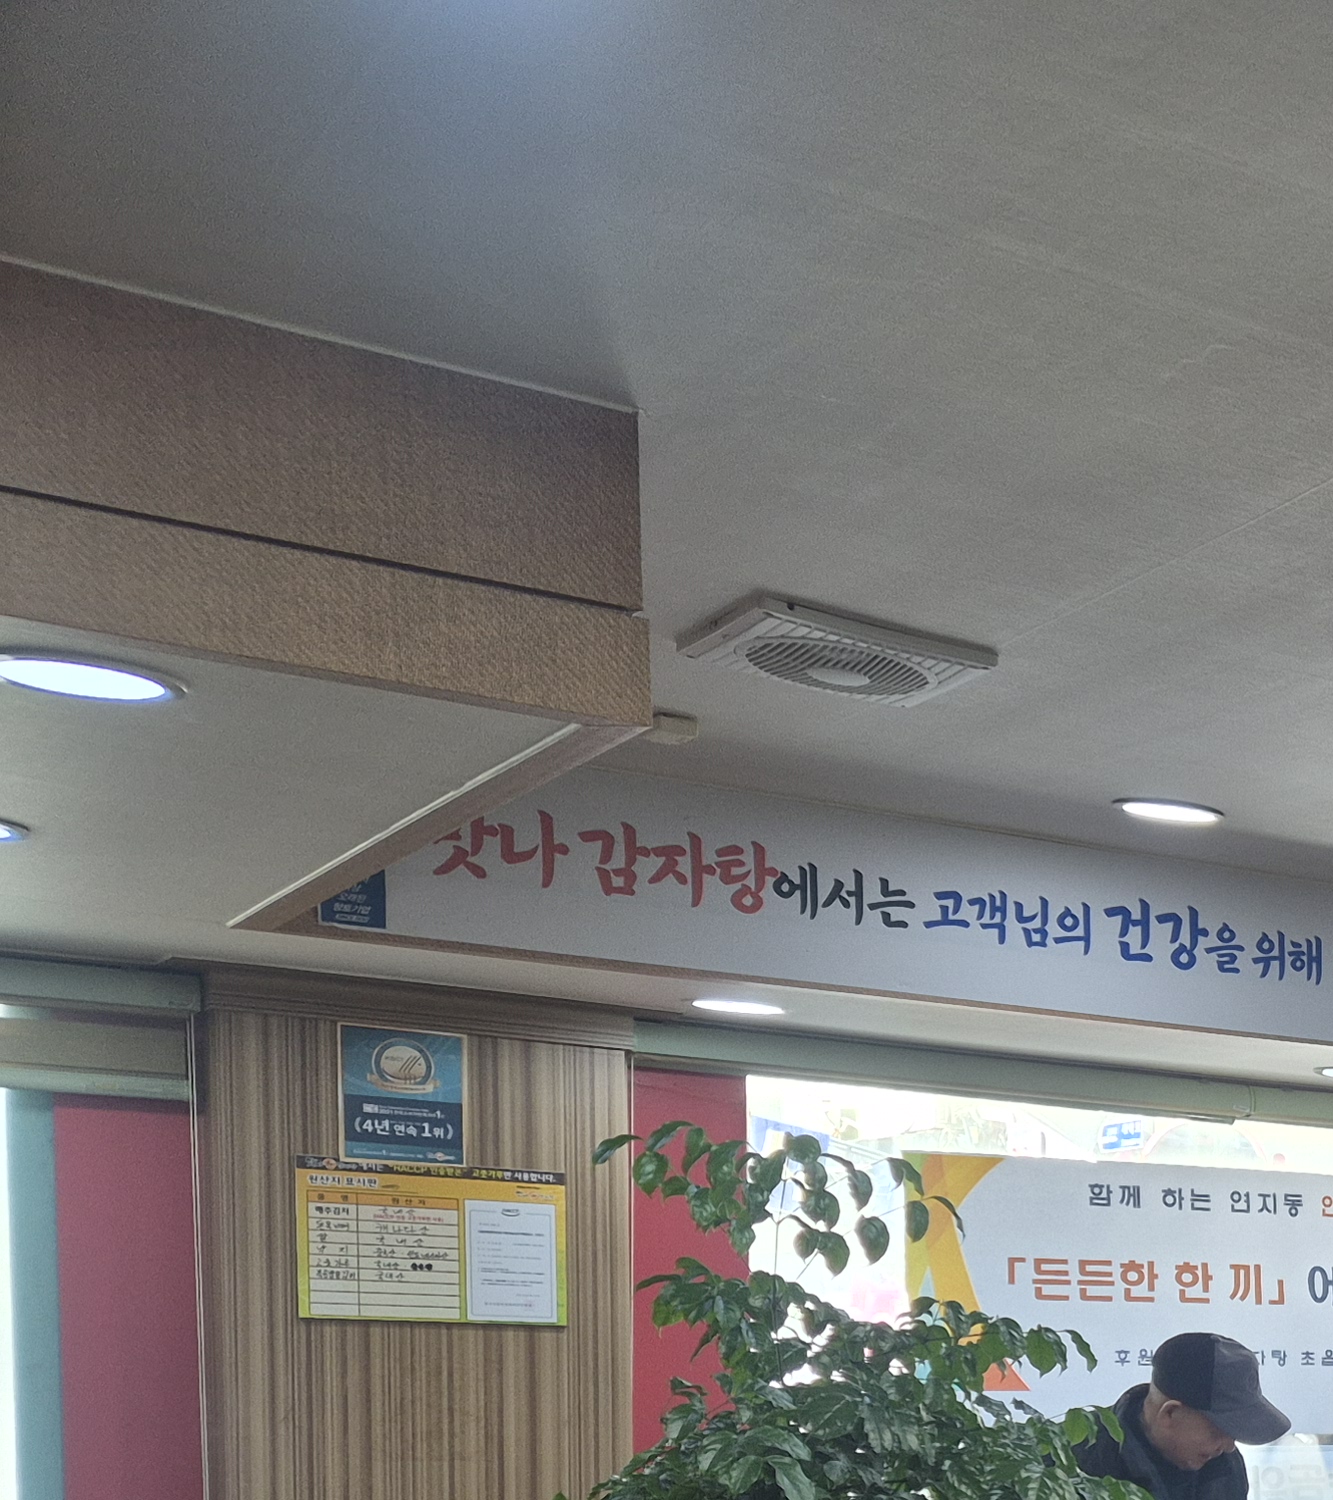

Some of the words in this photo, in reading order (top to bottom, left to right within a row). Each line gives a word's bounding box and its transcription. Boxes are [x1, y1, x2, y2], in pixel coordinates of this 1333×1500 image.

[577, 821, 918, 929] 감자탕에서는
[922, 889, 1092, 956] 고객님의
[1103, 892, 1247, 975] 건강을
[1251, 929, 1323, 986] 위해
[393, 1123, 418, 1138] 연속
[1088, 1183, 1141, 1209] 함께
[1161, 1187, 1212, 1212] 하는
[1229, 1190, 1304, 1218] 연지동
[1007, 1256, 1159, 1303] 「든든한
[1174, 1261, 1214, 1305] 한
[1229, 1263, 1285, 1306] 끼」
